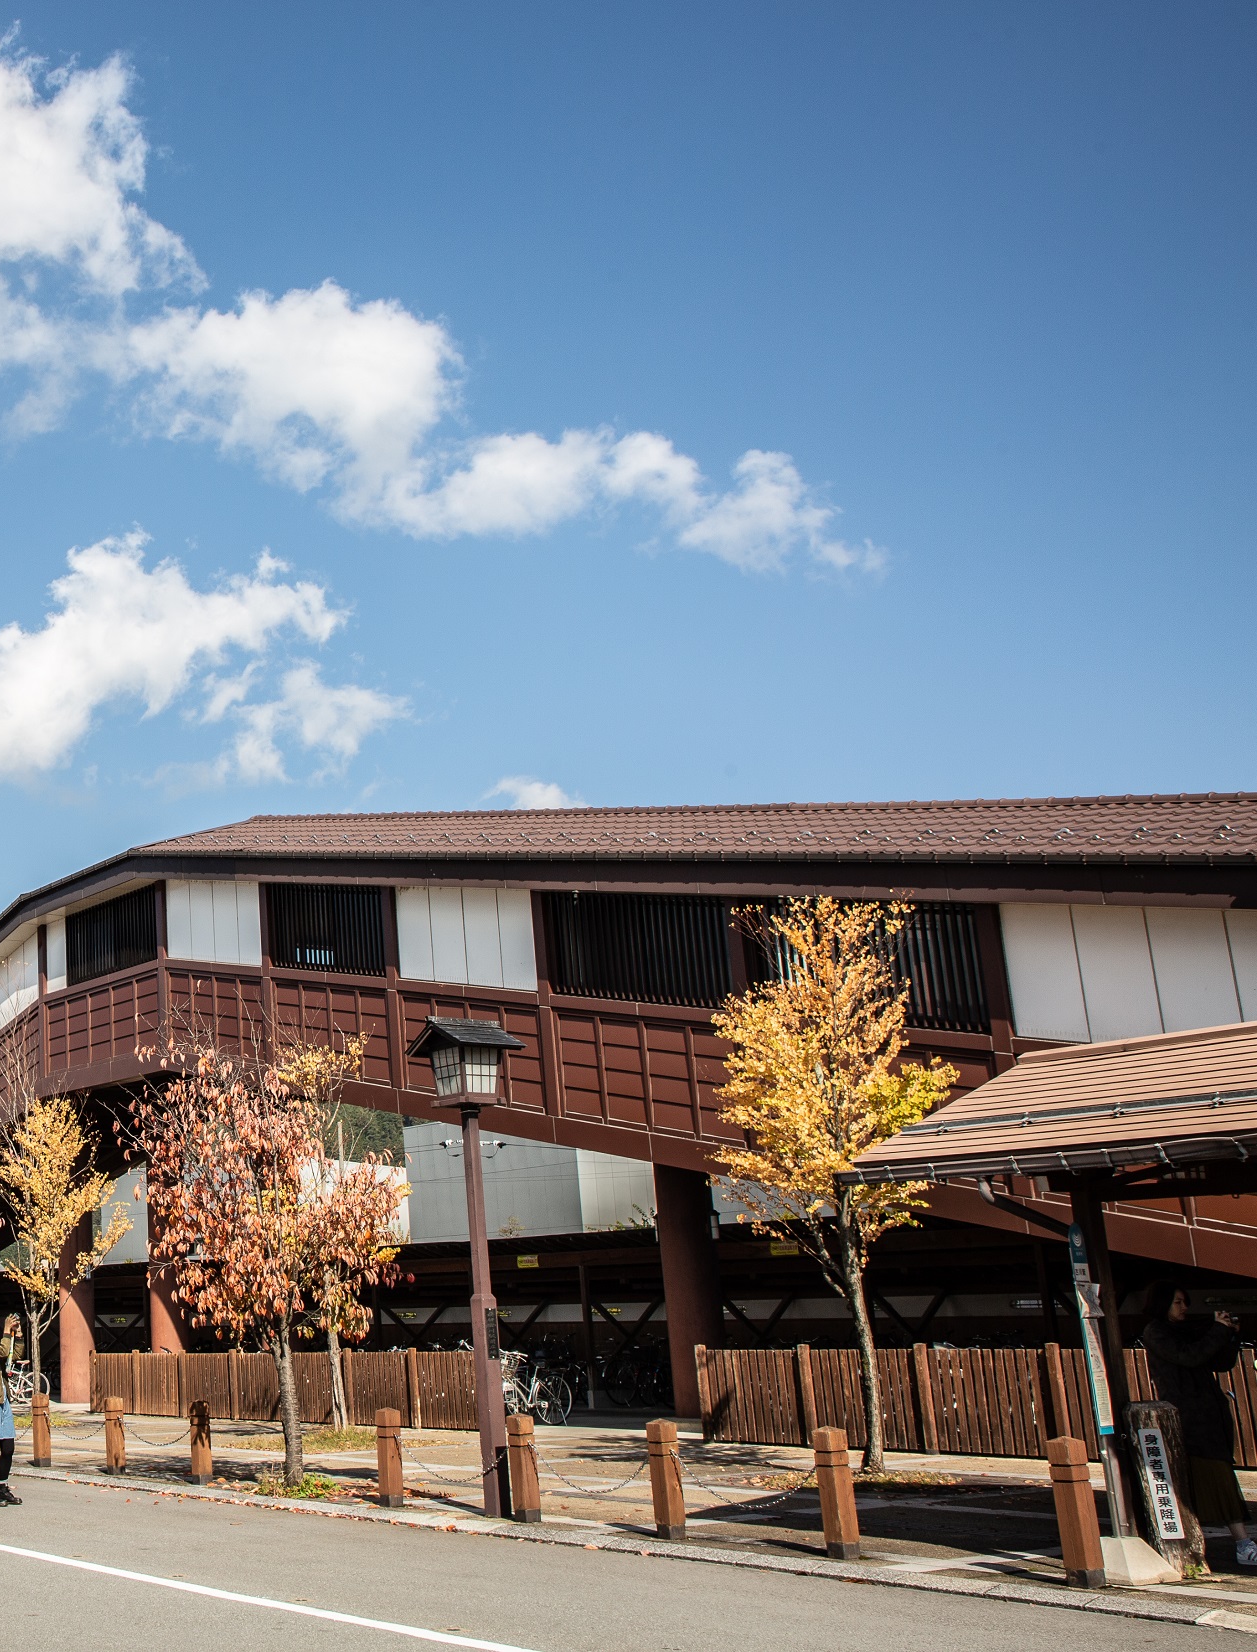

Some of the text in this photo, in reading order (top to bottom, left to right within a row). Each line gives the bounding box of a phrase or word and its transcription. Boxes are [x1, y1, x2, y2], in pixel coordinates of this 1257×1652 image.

[1143, 1433, 1178, 1533] 身障者専用乗降場
